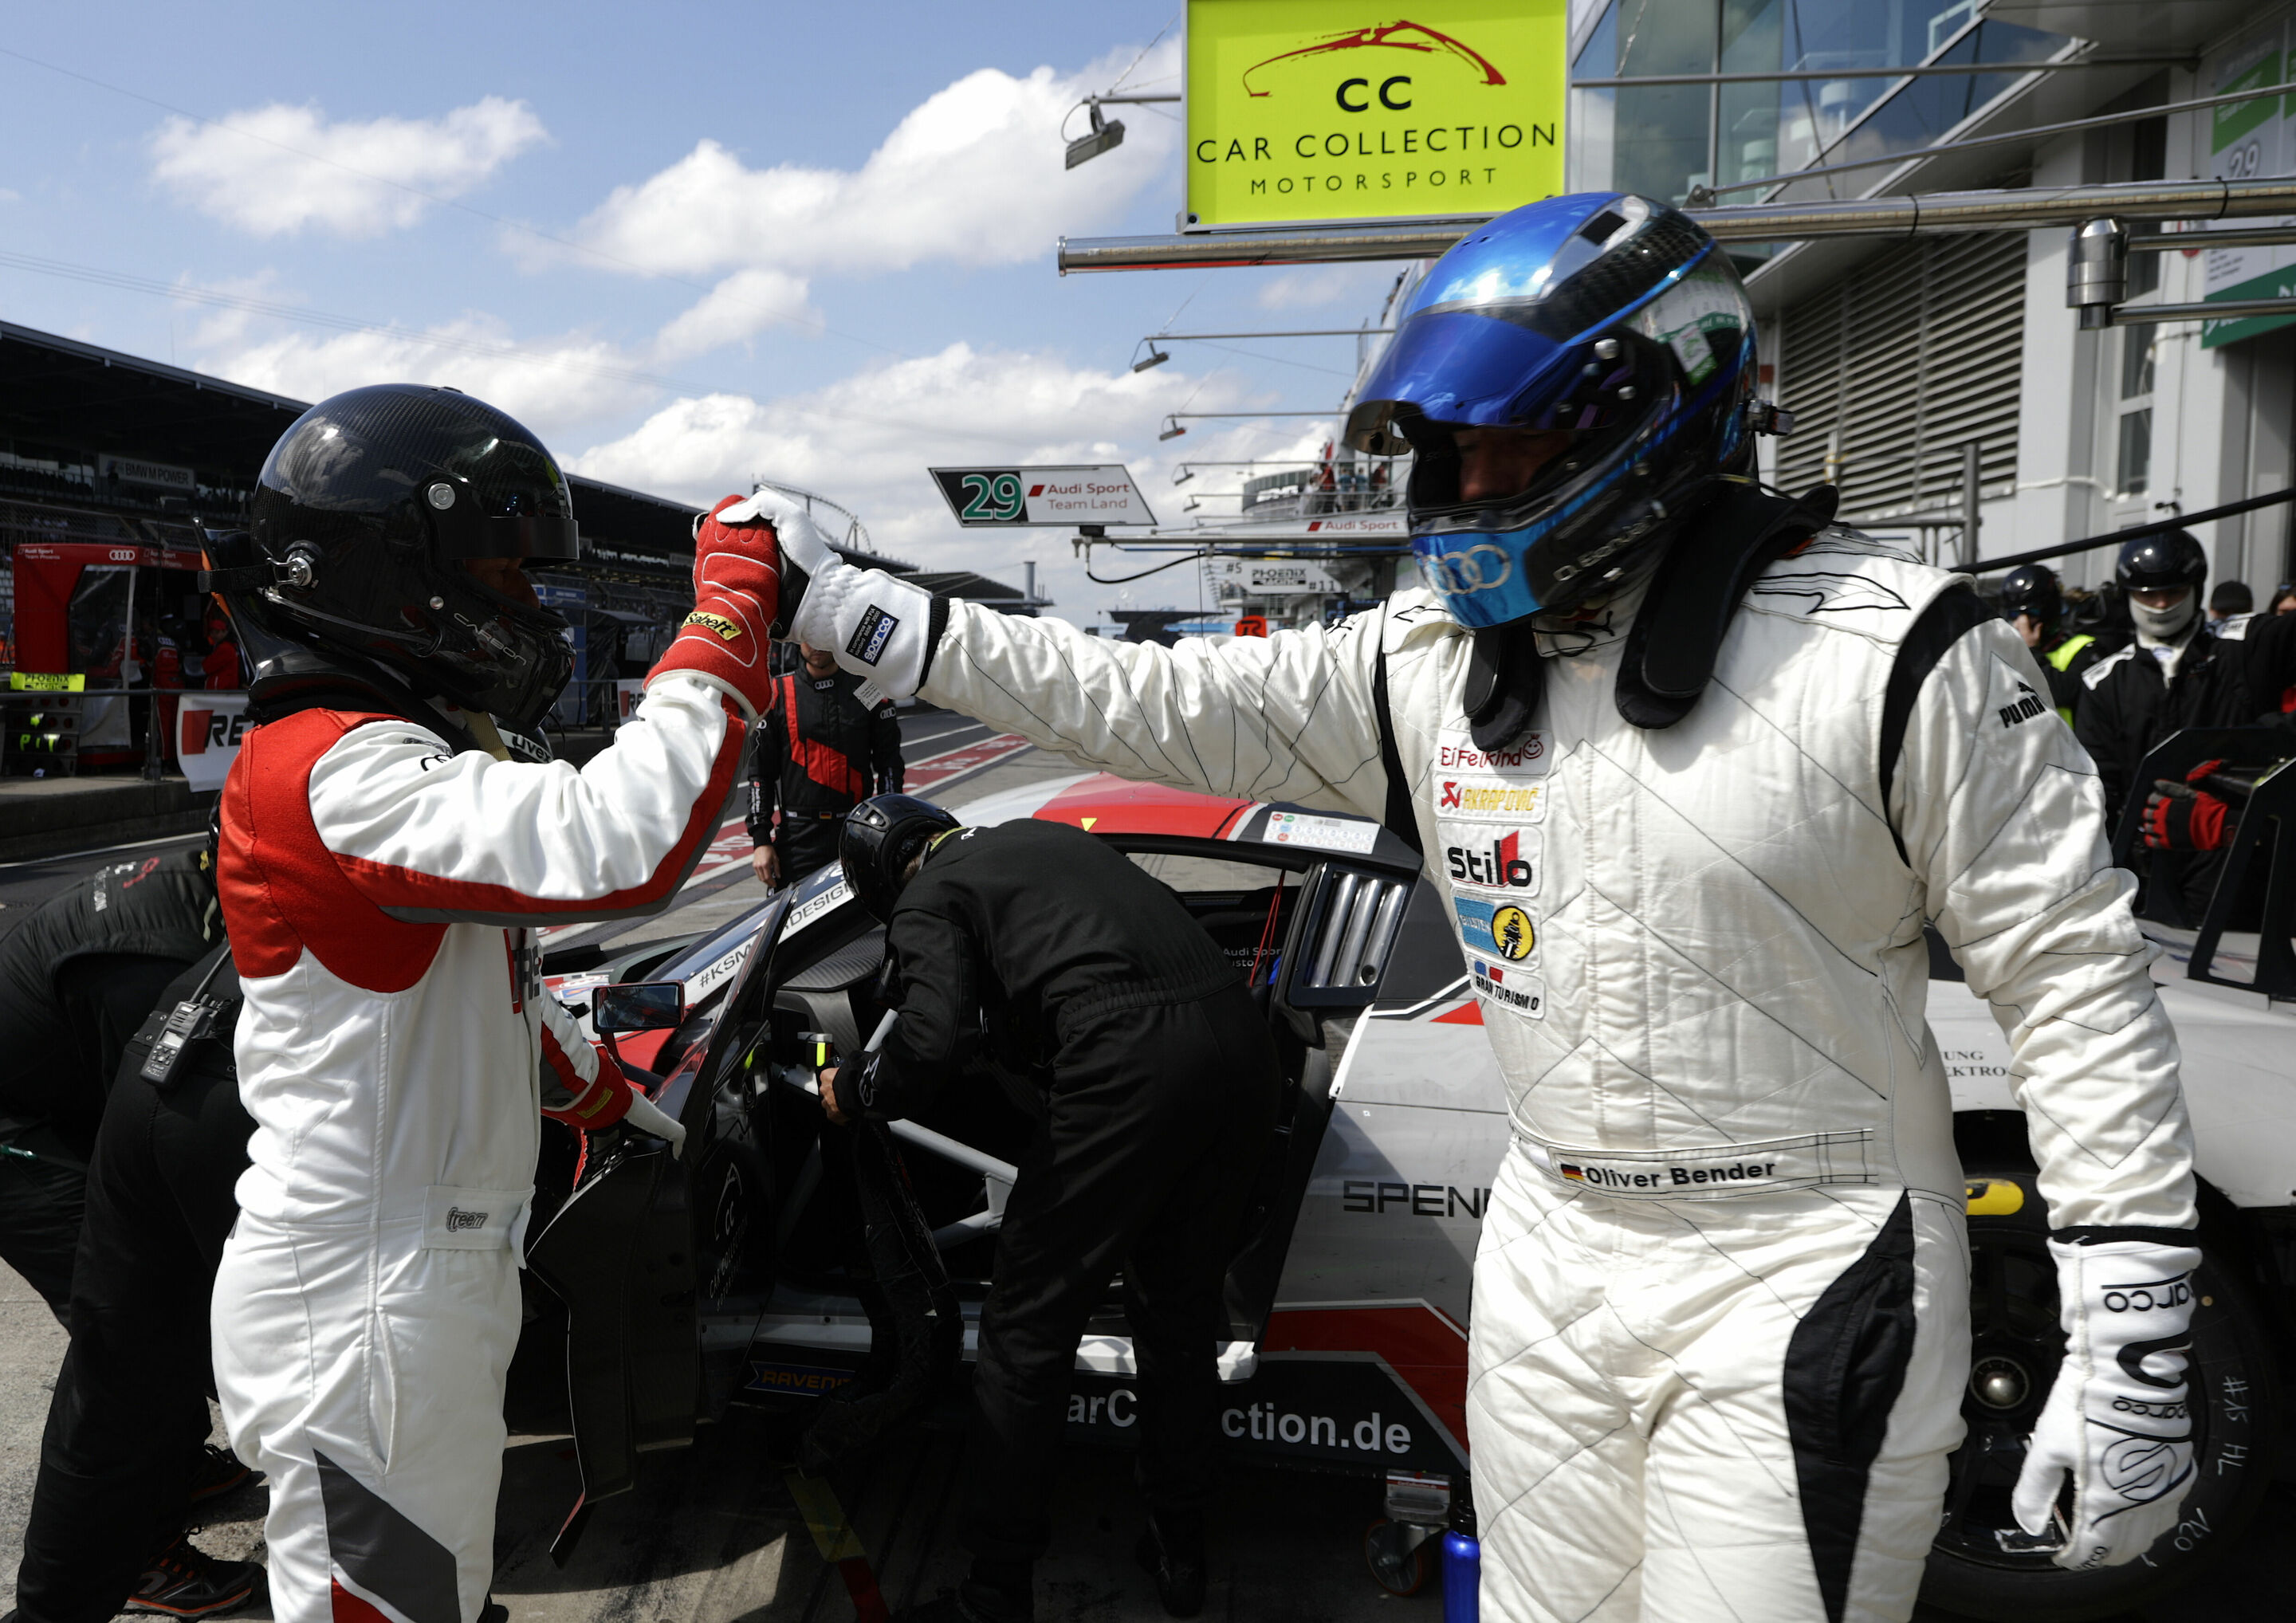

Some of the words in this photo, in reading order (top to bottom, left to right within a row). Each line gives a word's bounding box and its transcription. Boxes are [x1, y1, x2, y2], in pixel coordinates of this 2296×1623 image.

[1336, 76, 1412, 112] CC
[1197, 137, 1272, 163] CAR
[1295, 123, 1555, 158] COLLECTION
[1252, 168, 1497, 195] MOTORSPORT
[125, 462, 148, 477] BMW
[148, 466, 157, 479] M
[158, 469, 188, 485] POWER
[961, 474, 1024, 521] 29
[1048, 483, 1082, 494] Audi
[1087, 483, 1130, 496] Sport
[1048, 499, 1087, 509] Team
[1091, 498, 1127, 509] Land
[1325, 521, 1354, 530] Audi
[1360, 521, 1398, 532] Sport
[1226, 563, 1242, 573] #5
[1252, 568, 1307, 578] PHOENIX
[1309, 581, 1335, 592] #11
[862, 615, 894, 662] sparco
[1999, 695, 2046, 729] PUMA
[1448, 839, 1532, 887] Stilo
[1223, 947, 1249, 957] Audi
[1476, 975, 1493, 996] GRAN
[1495, 985, 1539, 1011] TURISMO
[1586, 1167, 1661, 1187] Oliver
[1669, 1162, 1776, 1186] Bender
[1343, 1180, 1492, 1219] SPEN
